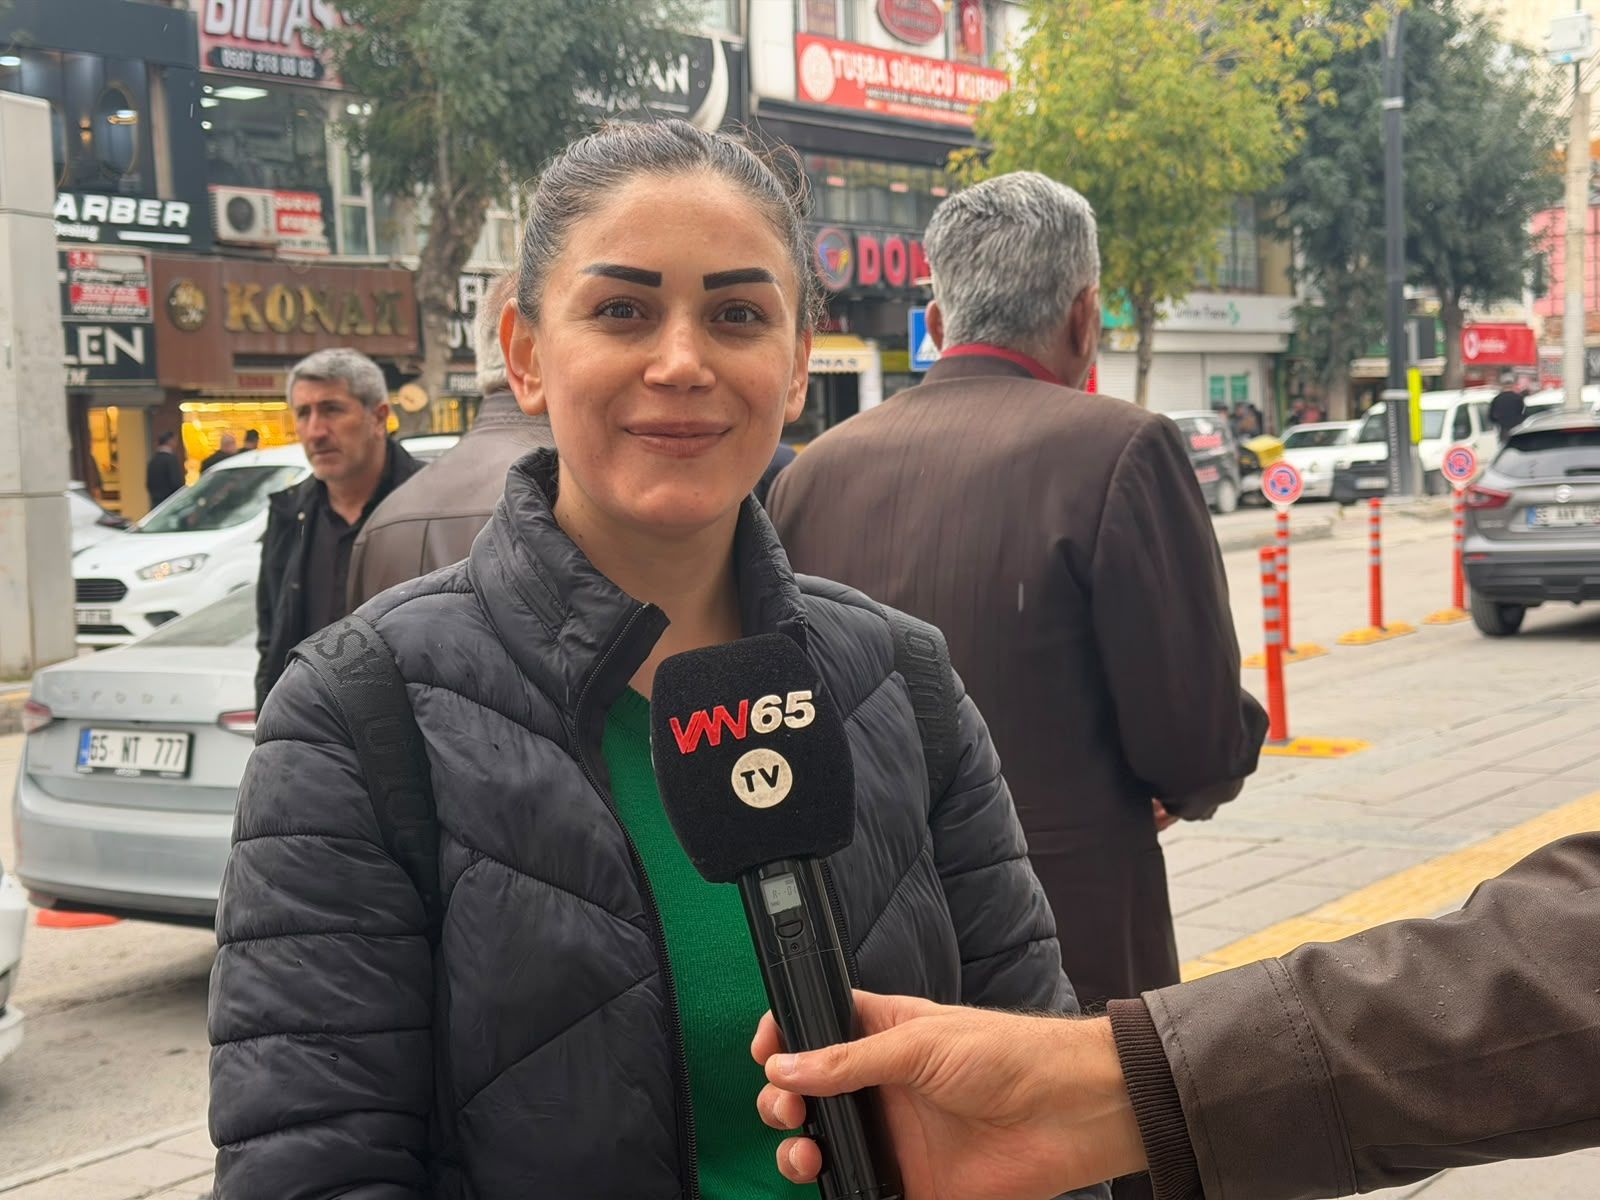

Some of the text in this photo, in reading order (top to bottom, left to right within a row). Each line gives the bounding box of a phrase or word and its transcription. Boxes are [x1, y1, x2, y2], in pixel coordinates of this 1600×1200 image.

[888, 56, 955, 97] SÜRÜCÜ
[90, 734, 184, 767] 65 NT 777
[740, 765, 781, 793] TV
